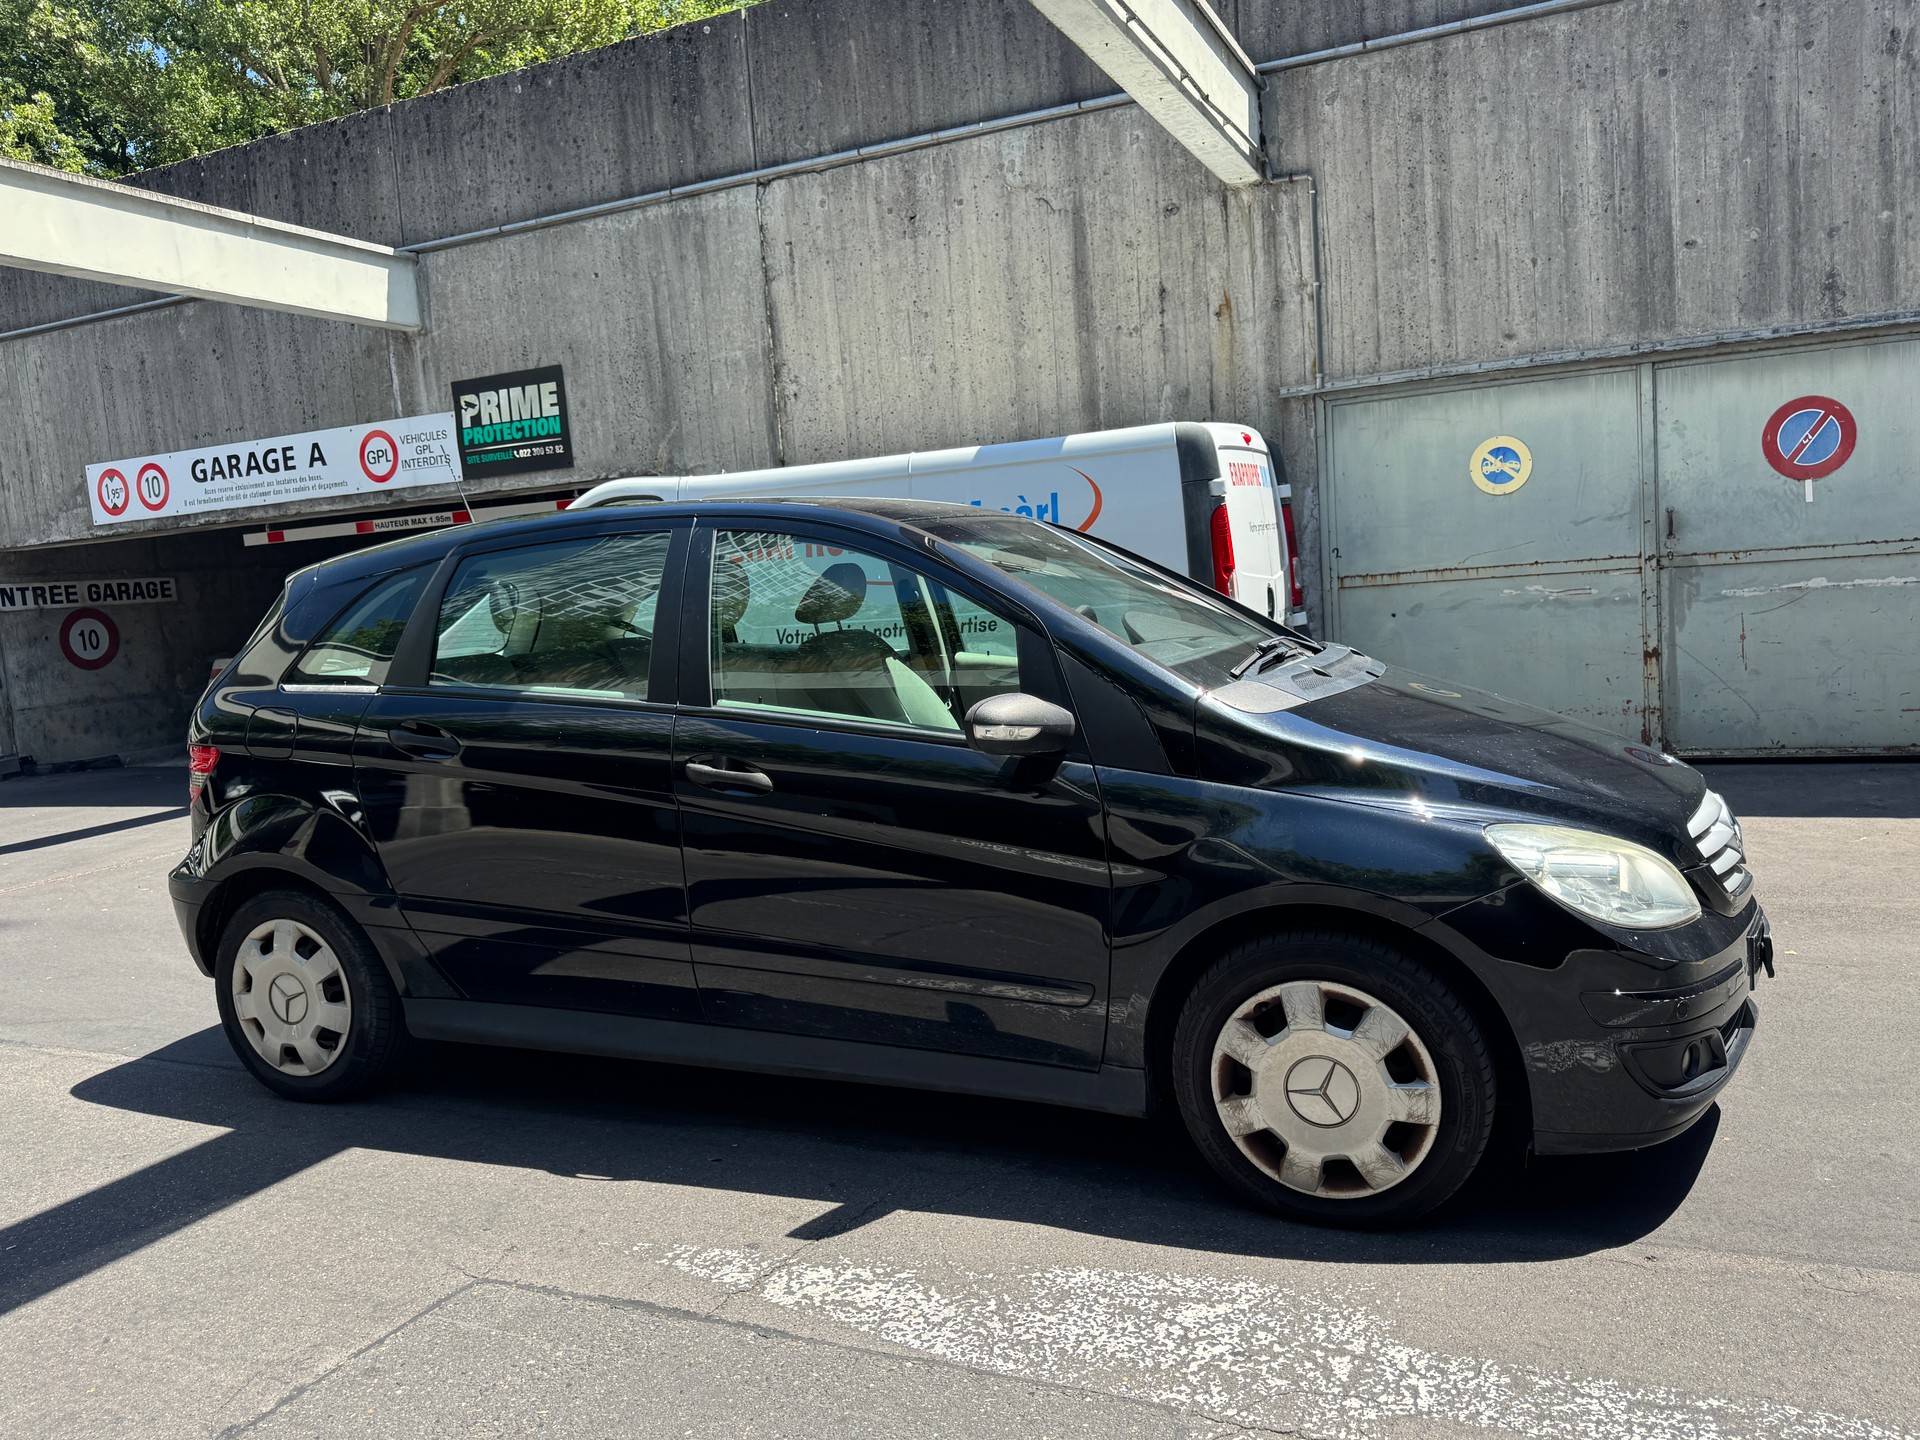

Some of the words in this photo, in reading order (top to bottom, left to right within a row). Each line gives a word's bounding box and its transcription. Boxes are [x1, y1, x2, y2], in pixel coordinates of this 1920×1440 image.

[460, 381, 559, 428] PRIME
[399, 429, 448, 445] VEHICULES
[463, 416, 561, 446] PROTECTION
[366, 448, 392, 465] GPL
[415, 444, 434, 455] GPL
[466, 455, 480, 464] SITE
[519, 448, 532, 458] 022
[191, 446, 296, 483] GARAGE
[308, 442, 328, 468] A
[401, 453, 451, 469] INTERDITS
[144, 475, 161, 499] 10
[1000, 492, 1059, 524] àrl
[374, 518, 410, 530] HAUTEUR
[411, 516, 428, 527] MAX
[430, 515, 452, 524] 1.95m
[86, 580, 173, 602] GARAGE
[873, 622, 906, 639] notr
[960, 616, 998, 634] rtise
[78, 629, 100, 651] 10
